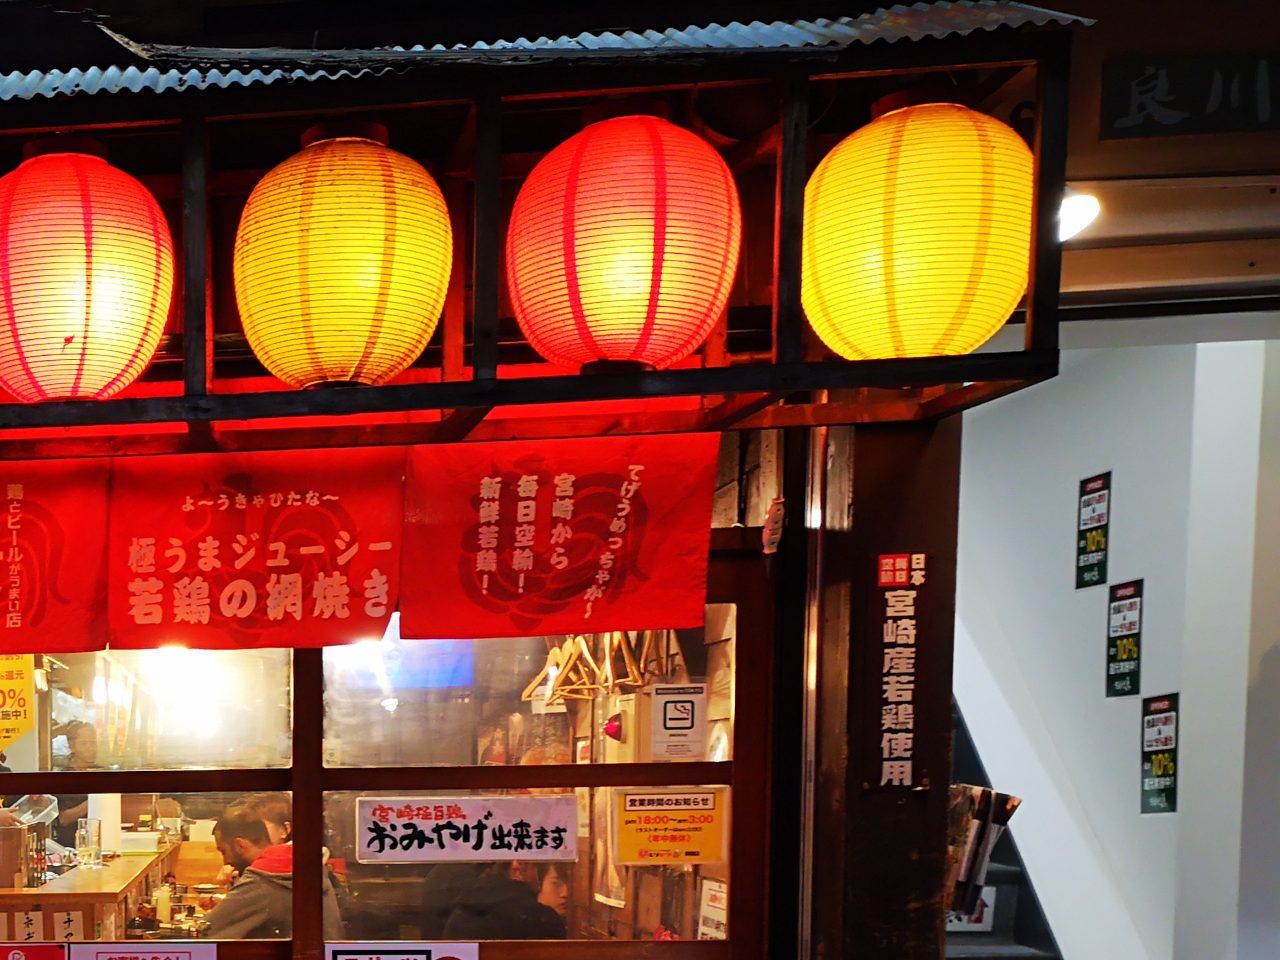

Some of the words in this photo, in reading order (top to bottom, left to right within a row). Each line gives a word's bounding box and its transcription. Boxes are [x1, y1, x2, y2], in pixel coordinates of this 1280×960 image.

[6, 484, 24, 628] 鶏とビールがうまい店
[127, 530, 392, 573] 極うまジューシー
[550, 473, 575, 569] 宮崎から
[127, 568, 389, 625] 若鶏の網焼き
[910, 554, 926, 586] 日本
[880, 590, 917, 786] 宮崎産若鶏使用
